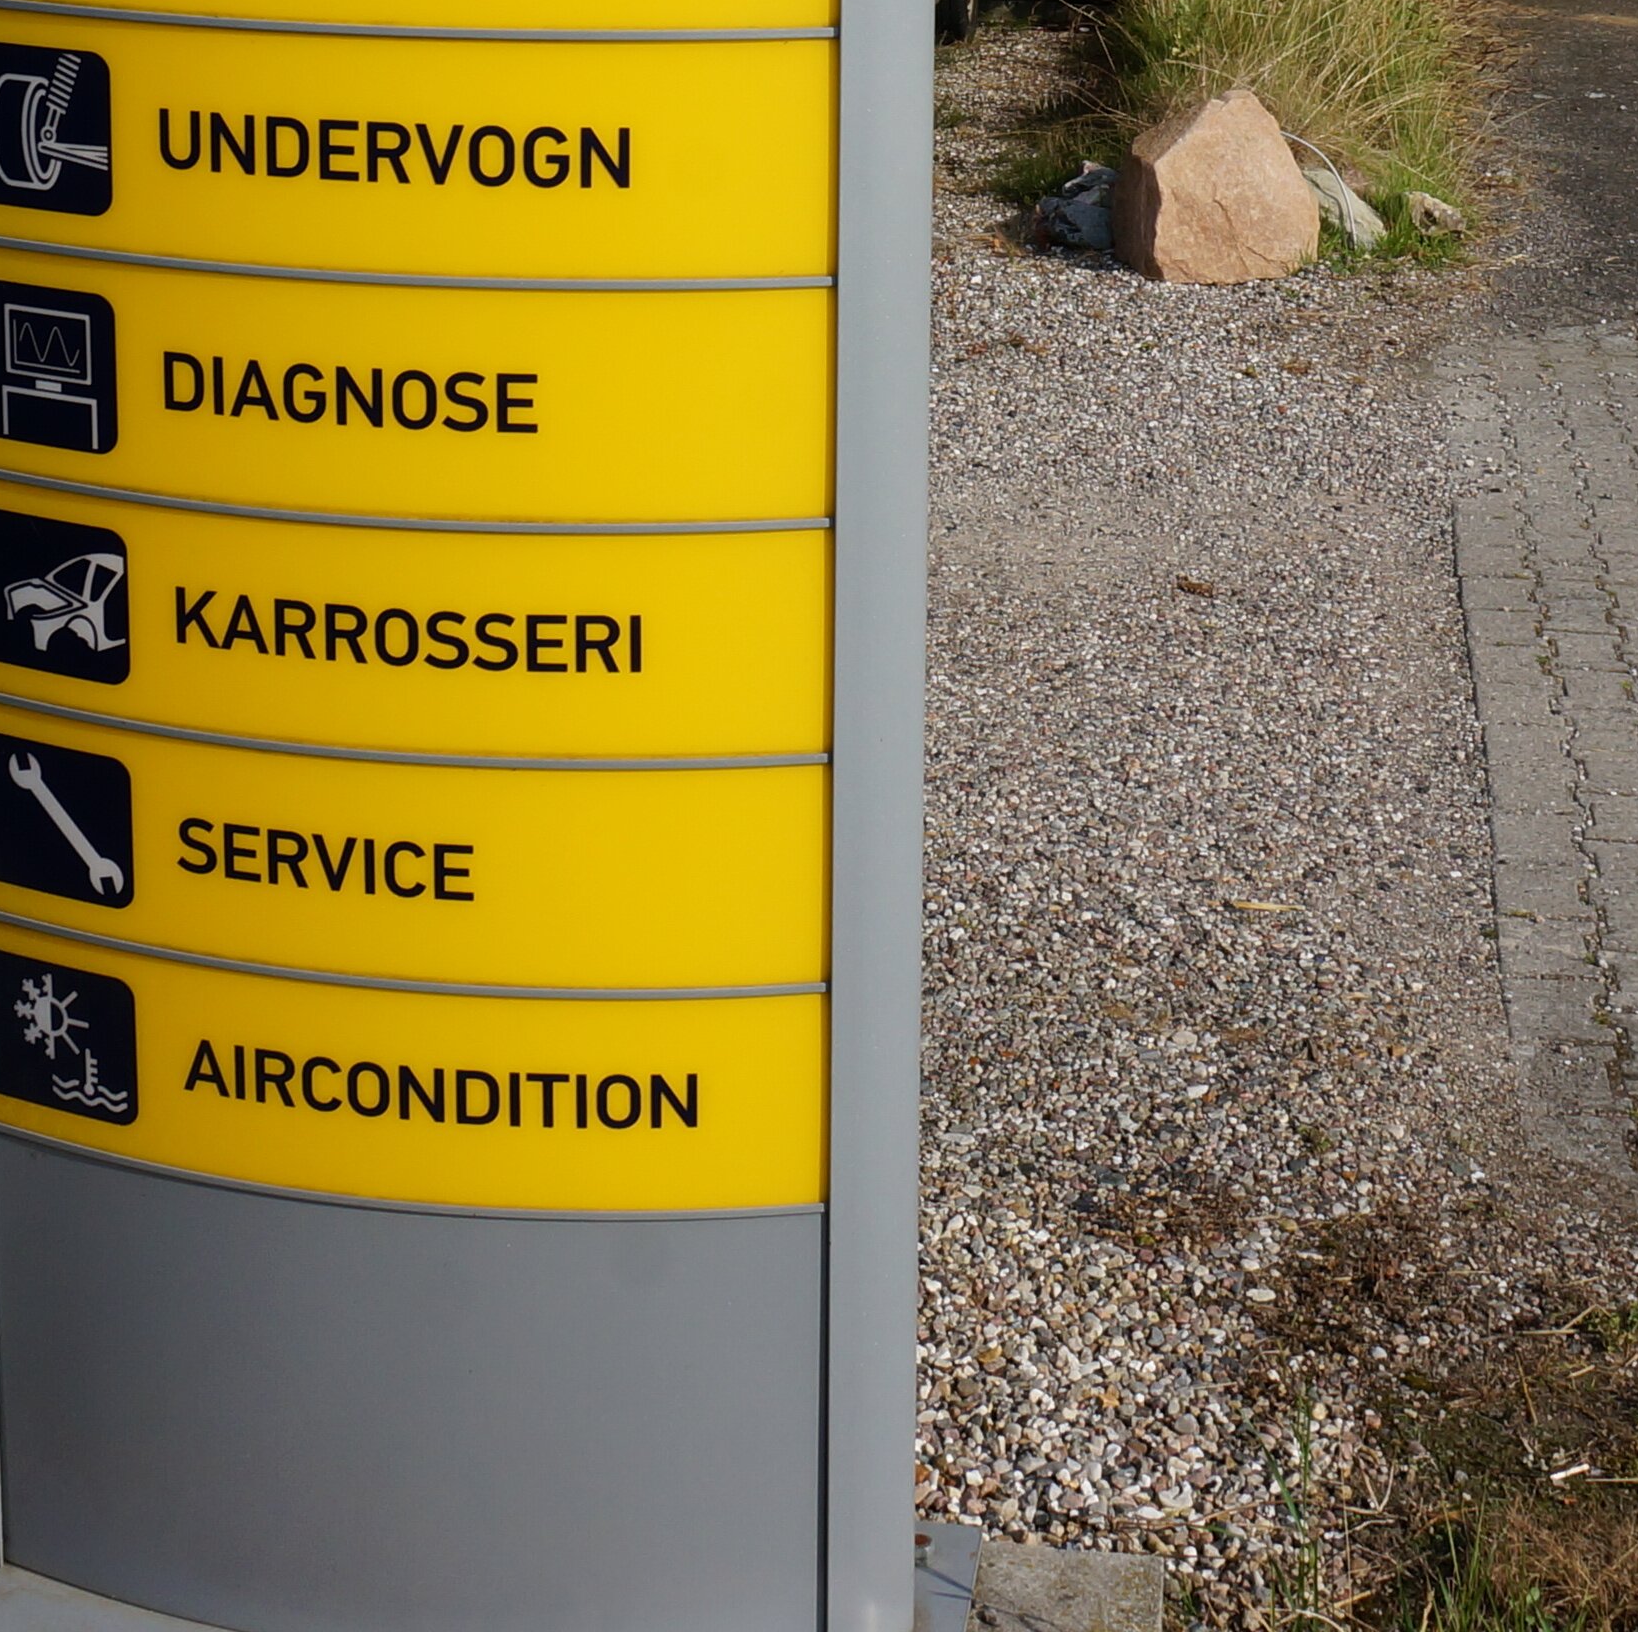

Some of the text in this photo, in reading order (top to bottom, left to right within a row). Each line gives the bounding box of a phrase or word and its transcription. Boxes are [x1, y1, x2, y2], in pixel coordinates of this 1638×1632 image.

[159, 107, 631, 189] UNDERVOGN
[163, 350, 539, 434] DIAGNOSE
[175, 586, 643, 674] KARROSSERI
[176, 817, 476, 902] SERVICE
[183, 1039, 699, 1130] AIRCONDITION
